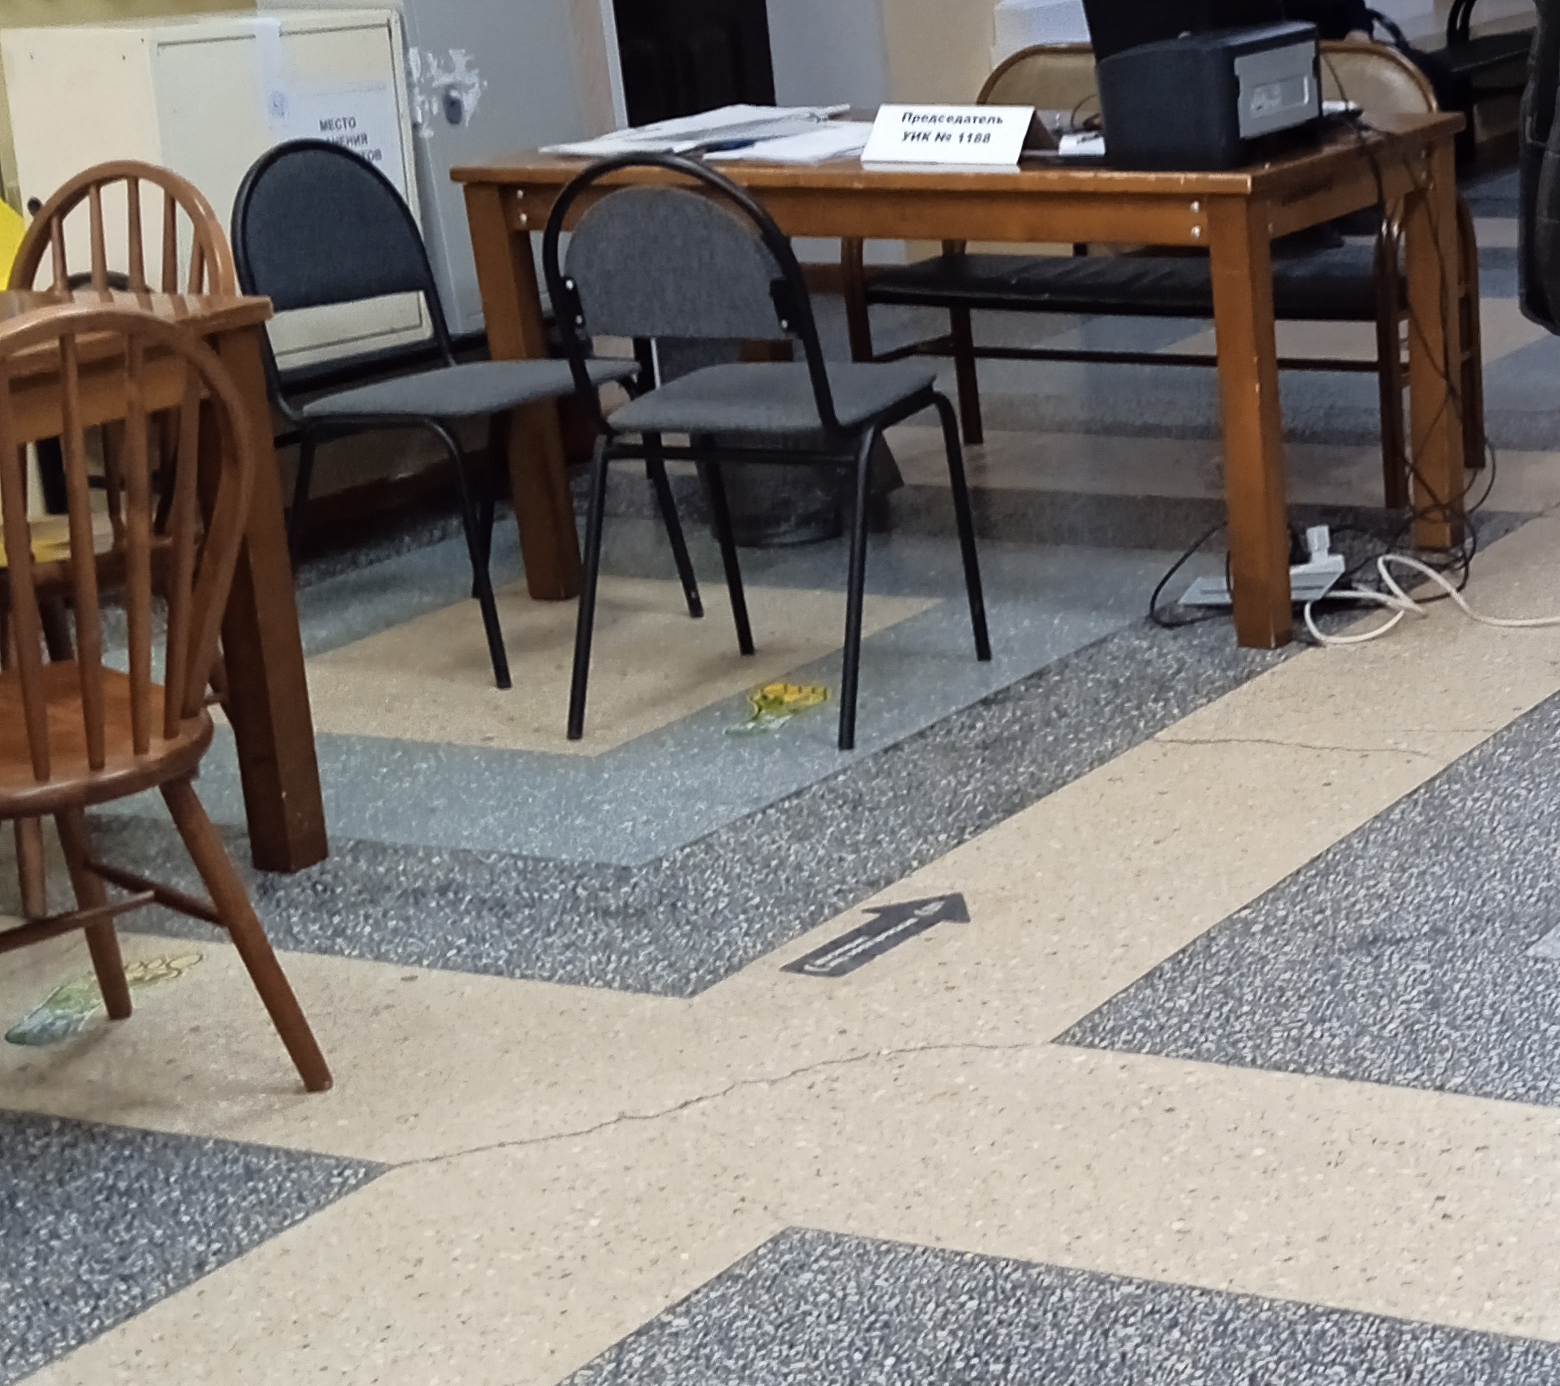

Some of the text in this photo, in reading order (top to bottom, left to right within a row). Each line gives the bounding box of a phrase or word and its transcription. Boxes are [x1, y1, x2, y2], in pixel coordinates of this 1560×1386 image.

[319, 116, 357, 131] МЕСТО
[902, 111, 1004, 125] Председатель
[902, 132, 931, 143] УИК
[935, 132, 952, 143] №
